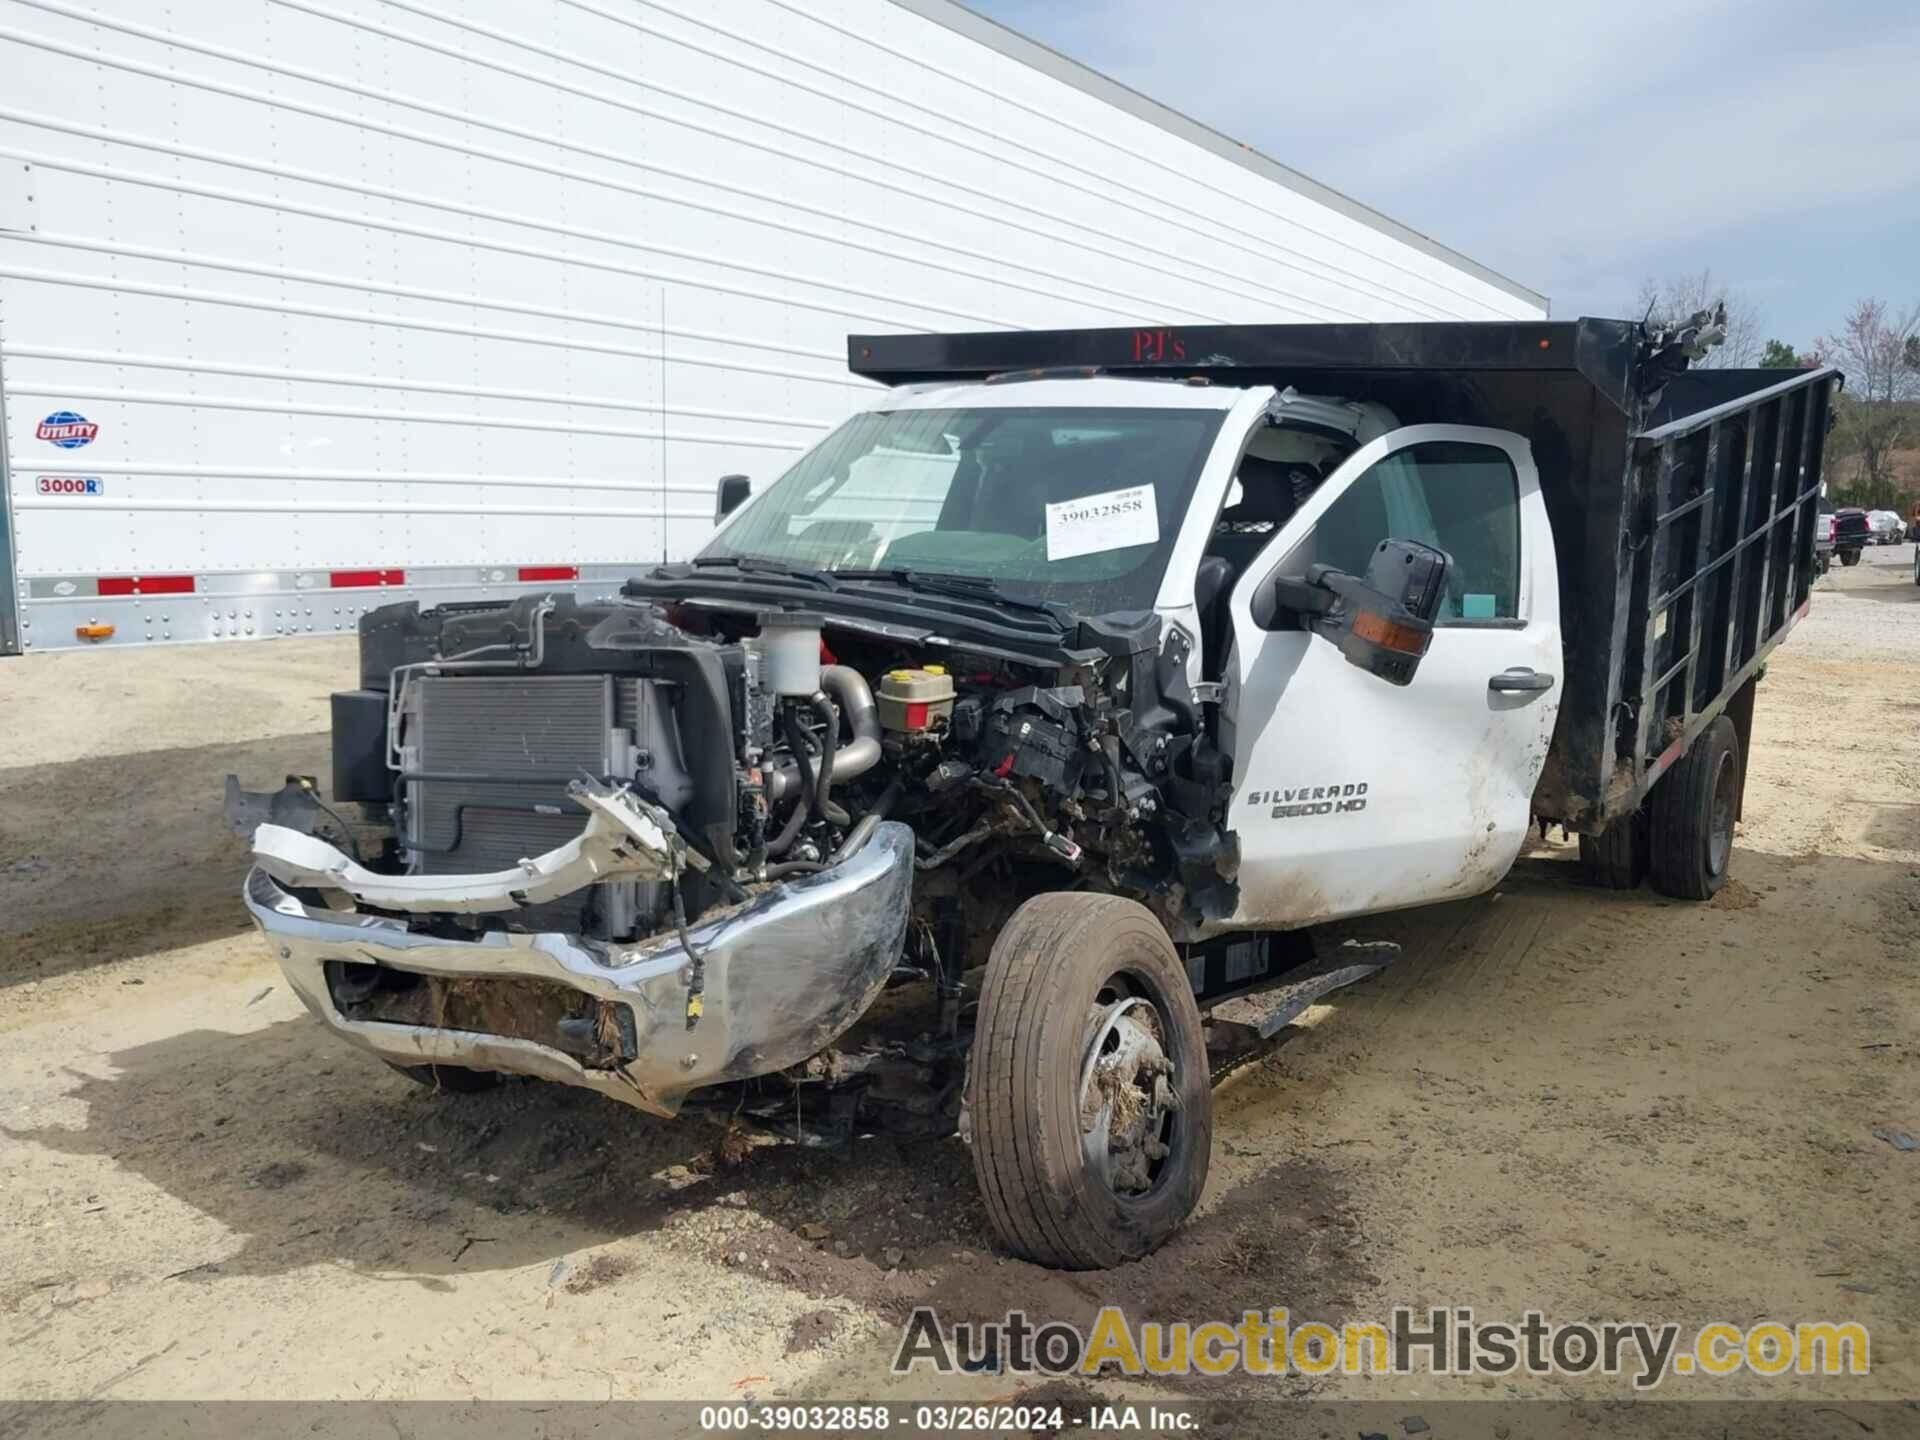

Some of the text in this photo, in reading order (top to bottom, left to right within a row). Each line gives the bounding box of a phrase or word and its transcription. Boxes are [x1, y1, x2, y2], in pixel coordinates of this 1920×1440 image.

[1131, 328, 1185, 361] PJ's
[40, 424, 96, 439] UTILITY
[40, 479, 97, 493] 3000R
[1058, 499, 1143, 524] 39032858
[1247, 782, 1368, 805] SILVERADO
